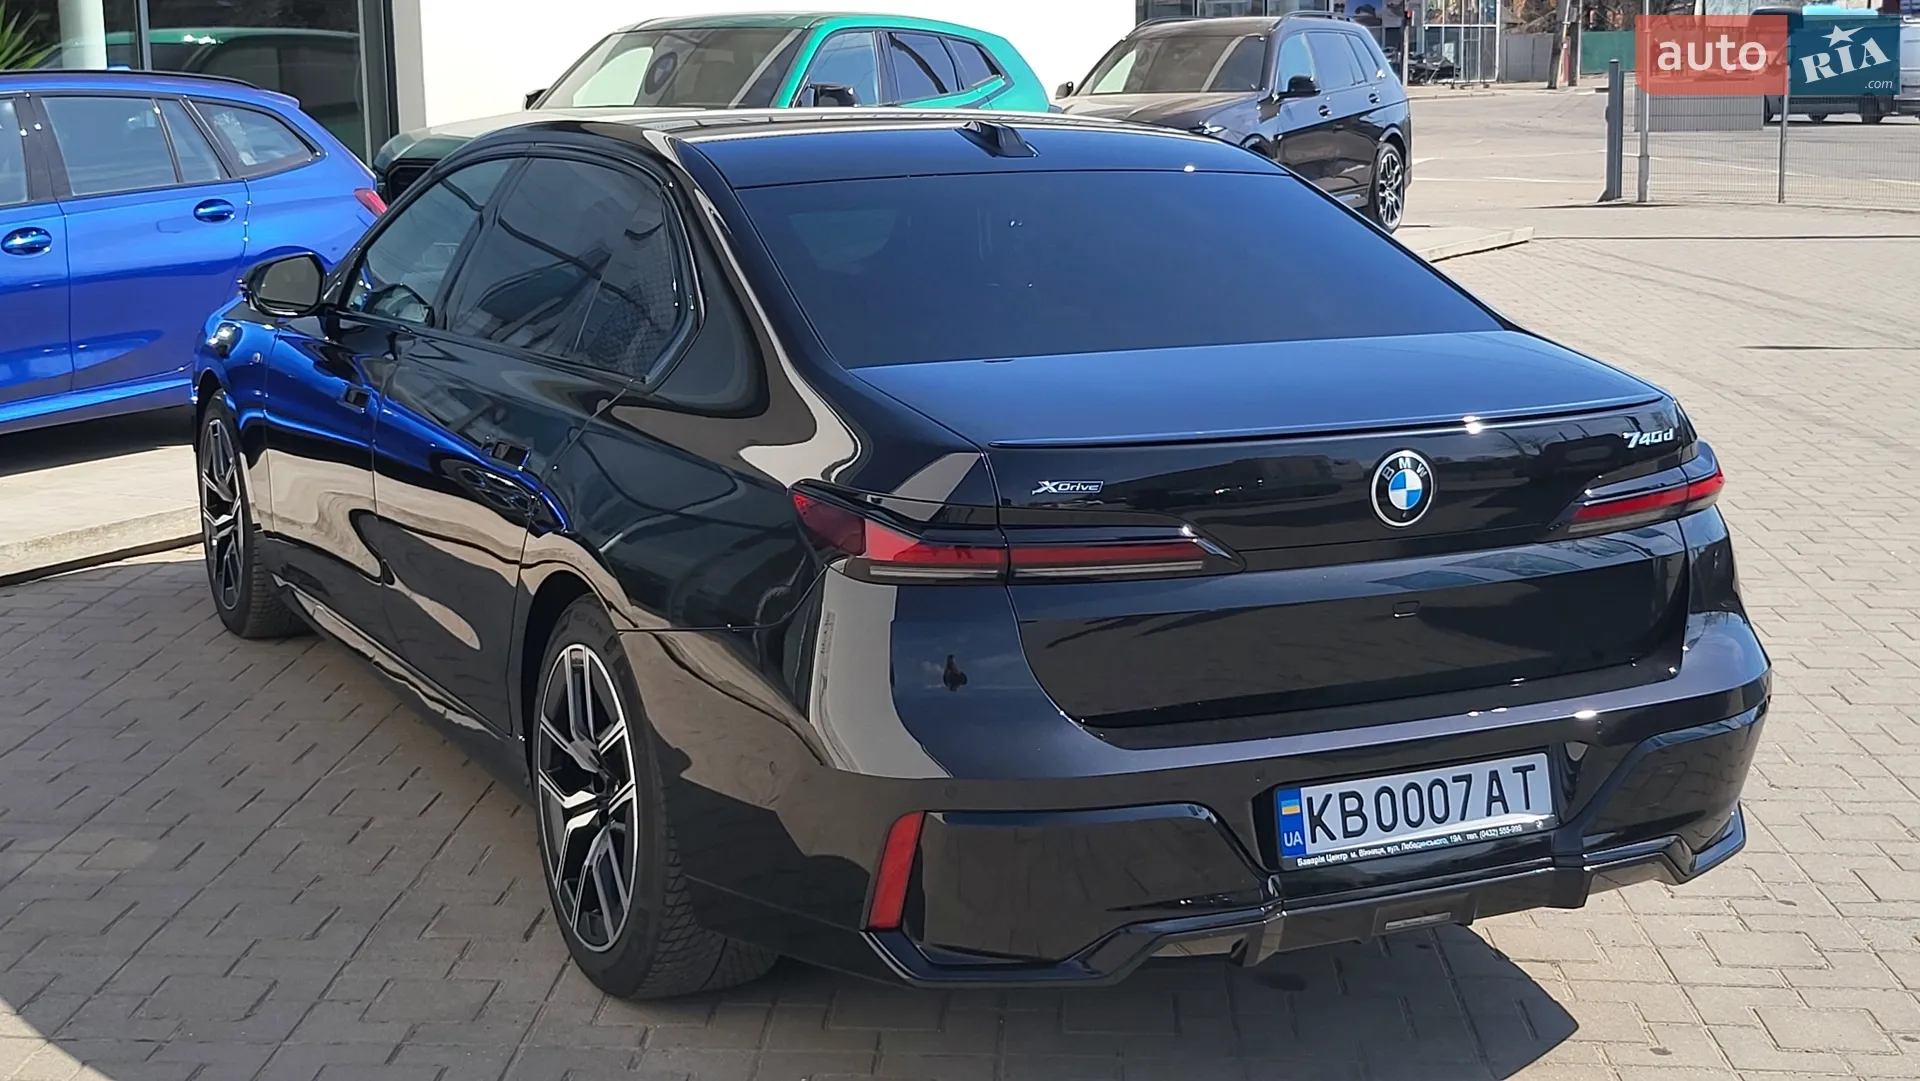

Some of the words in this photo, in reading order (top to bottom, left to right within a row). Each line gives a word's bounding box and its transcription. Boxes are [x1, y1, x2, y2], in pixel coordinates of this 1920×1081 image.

[1622, 428, 1674, 449] 740d
[1382, 457, 1428, 481] BMW
[1283, 831, 1303, 847] UA
[1326, 852, 1348, 863] Центр
